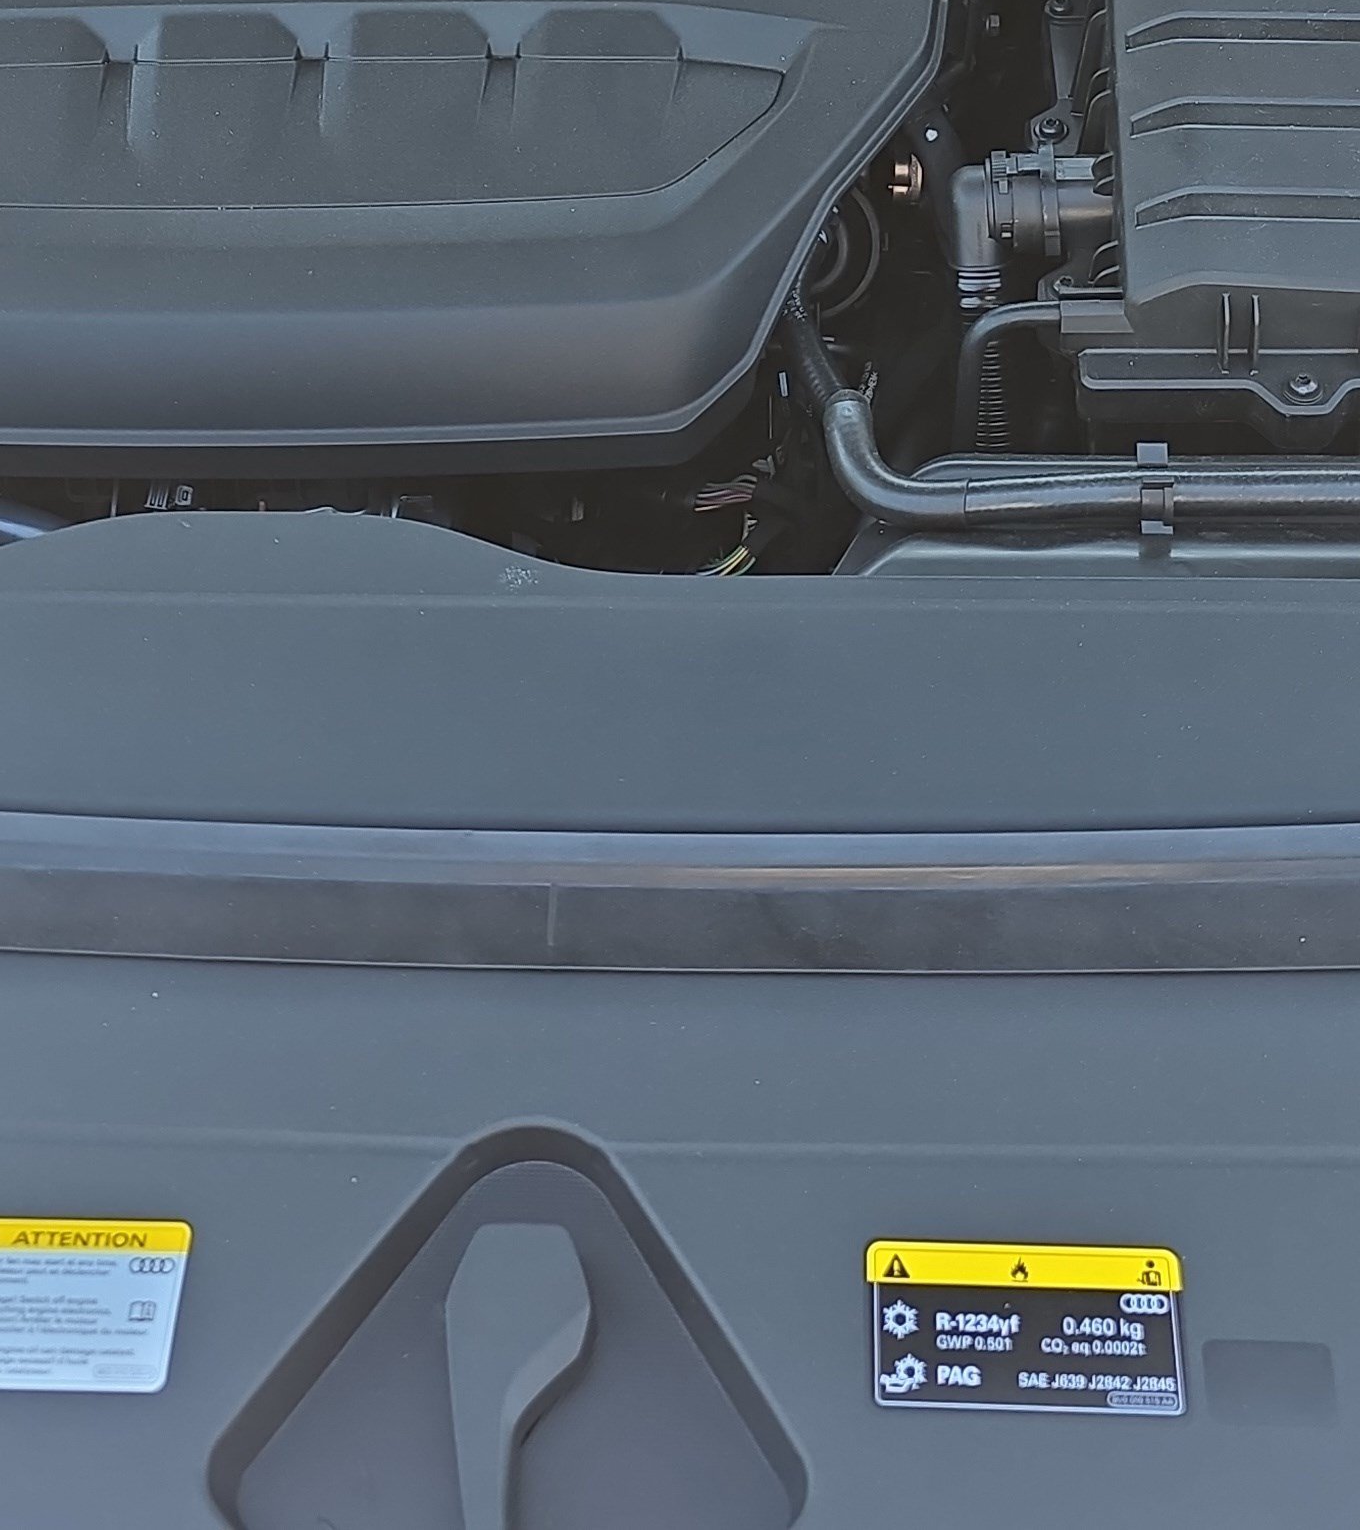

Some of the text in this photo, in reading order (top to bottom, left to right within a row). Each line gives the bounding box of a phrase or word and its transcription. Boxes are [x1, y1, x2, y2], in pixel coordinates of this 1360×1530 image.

[13, 1230, 148, 1248] ATTENTION
[935, 1312, 1145, 1341] R-1234yf 0.460 kg
[936, 1334, 973, 1350] GWP
[974, 1336, 1013, 1351] 0.501
[1071, 1342, 1092, 1357] eq
[1092, 1339, 1148, 1357] 0.0002t
[937, 1365, 982, 1387] PAG
[1018, 1371, 1051, 1389] SAE
[1051, 1373, 1088, 1390] J639
[1088, 1374, 1132, 1391] J2842
